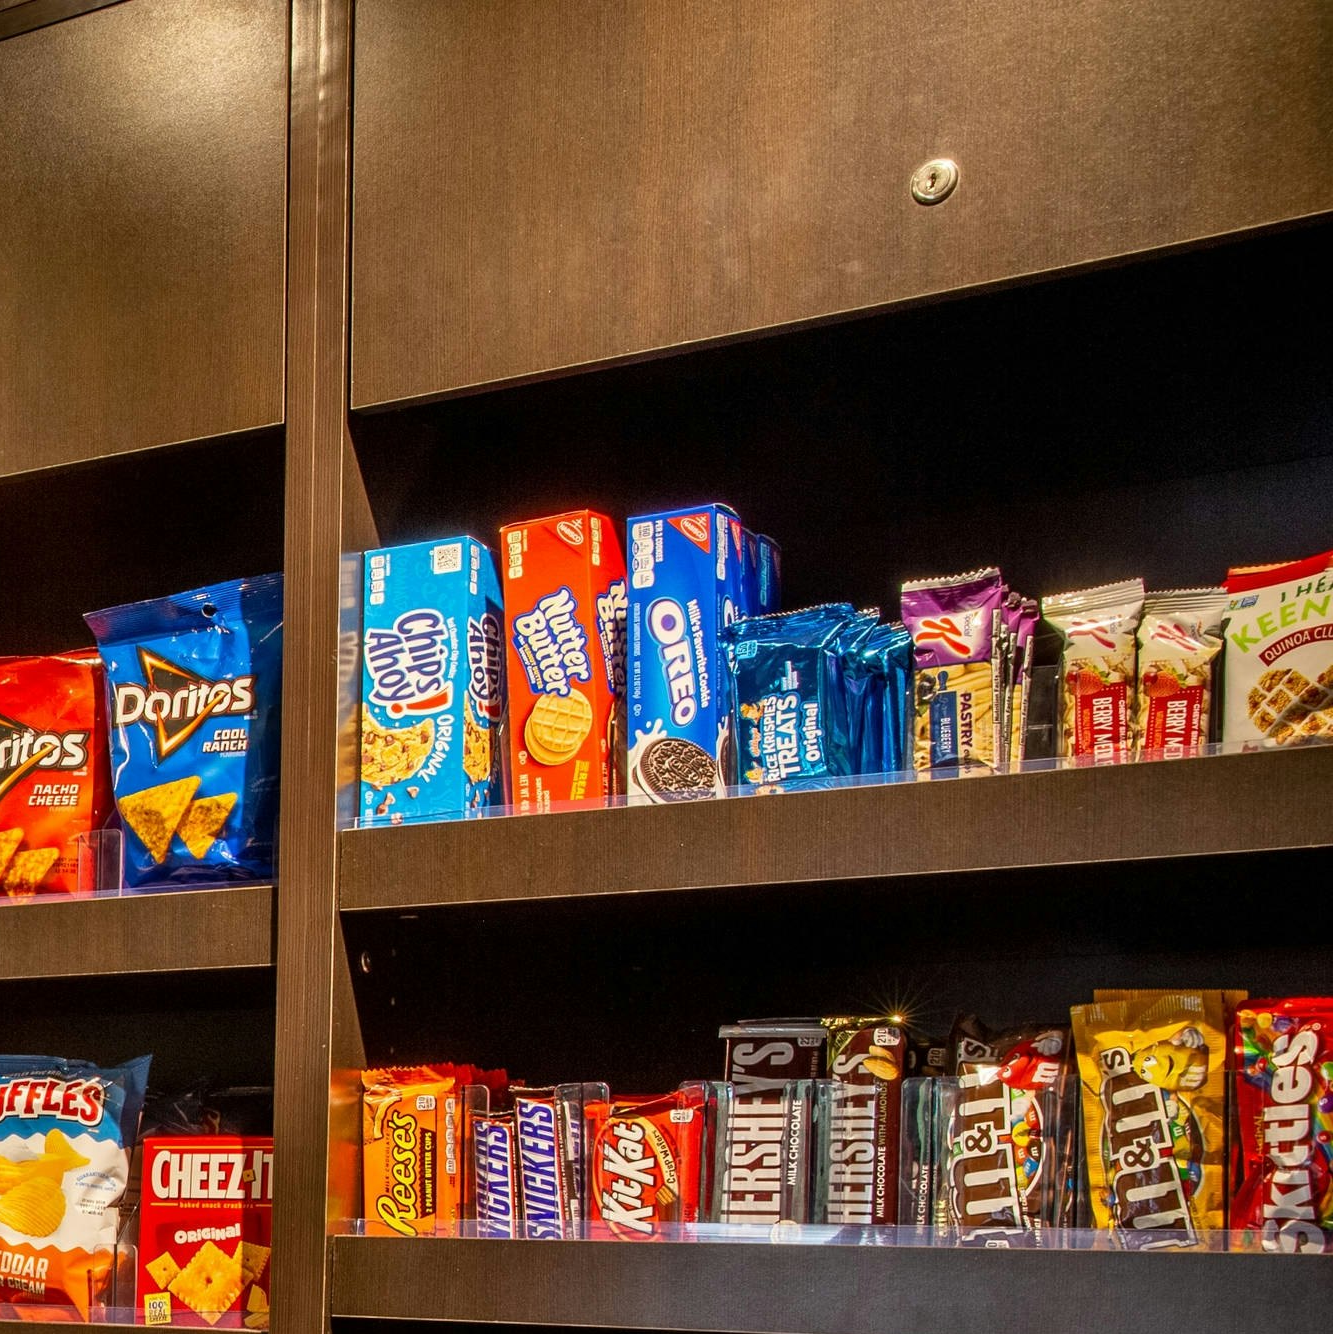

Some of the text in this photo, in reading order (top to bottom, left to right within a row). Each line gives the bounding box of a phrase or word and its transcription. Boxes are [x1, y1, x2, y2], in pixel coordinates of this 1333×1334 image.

[1296, 575, 1333, 598] HEA
[395, 611, 442, 693] Chips
[516, 612, 571, 697] Butter
[539, 588, 591, 683] Nutter
[647, 597, 697, 727] OREO
[687, 599, 709, 708] Milk's Favorite Cookie
[1264, 627, 1312, 659] QUINOA
[114, 677, 255, 726] Doritos
[961, 693, 973, 747] PASTRY
[1093, 696, 1113, 734] BERRY
[1166, 699, 1188, 737] BERRY
[202, 738, 247, 753] RANCH
[213, 729, 247, 743] COOL
[417, 714, 454, 782] ORIGINAL
[763, 696, 781, 783] RICE KRISPIES
[777, 695, 801, 780] TREATS
[805, 702, 822, 762] Original
[940, 717, 950, 753] BLUEBERRY
[28, 793, 79, 807] CHEESE
[33, 784, 80, 798] NACHO
[424, 1132, 433, 1207] PEANUT BUTTER CUPS
[788, 1099, 802, 1186] MILK CHOCOLATE
[875, 1145, 887, 1218] MILK CHOCOLATE
[7, 1277, 46, 1295] CREAM
